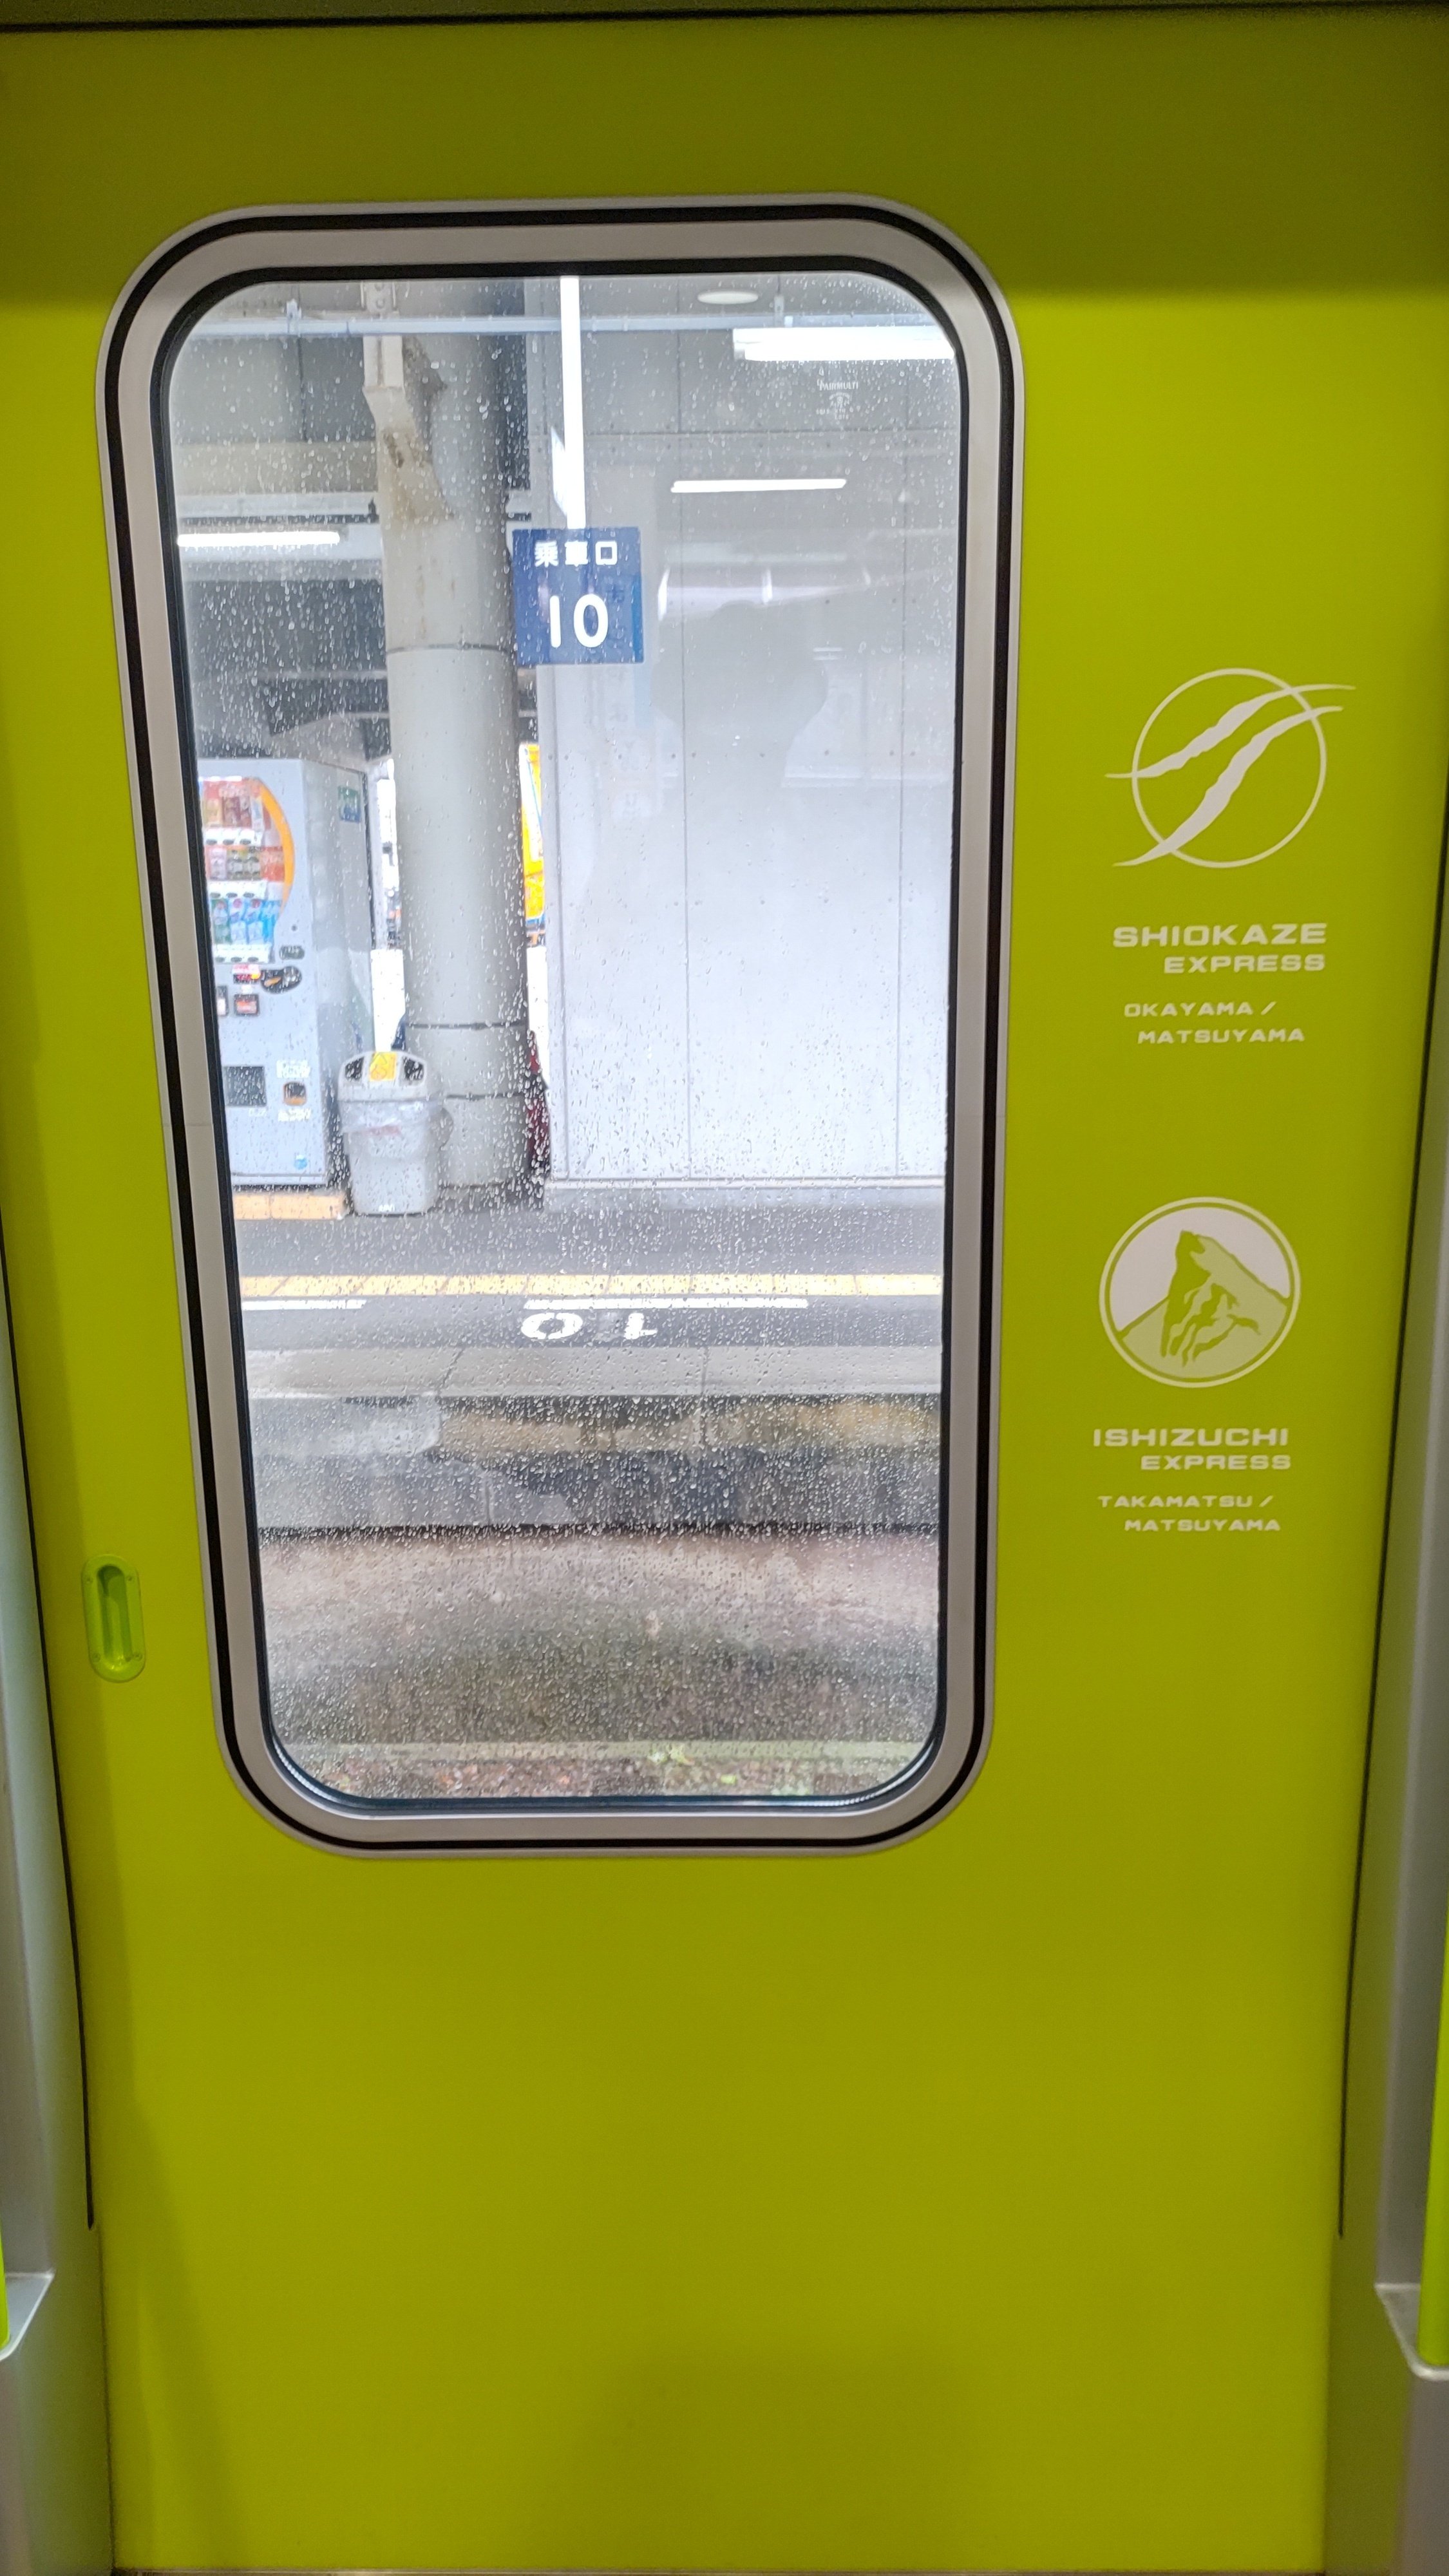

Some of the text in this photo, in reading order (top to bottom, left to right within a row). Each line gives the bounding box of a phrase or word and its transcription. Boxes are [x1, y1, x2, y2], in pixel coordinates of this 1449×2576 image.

[535, 540, 618, 567] 乗車口
[549, 594, 609, 648] 10
[1113, 923, 1327, 947] SHIOKAZE
[1164, 954, 1325, 974] EXPRESS
[1124, 1002, 1253, 1017] OKAYAMA
[1137, 1028, 1305, 1044] MATSUYAMA
[1093, 1428, 1288, 1447] ISHIZUCHI
[1141, 1455, 1291, 1470] EXPRESS
[1097, 1495, 1253, 1508] TAKAMATSU
[1124, 1519, 1280, 1531] MATSUYAMA
